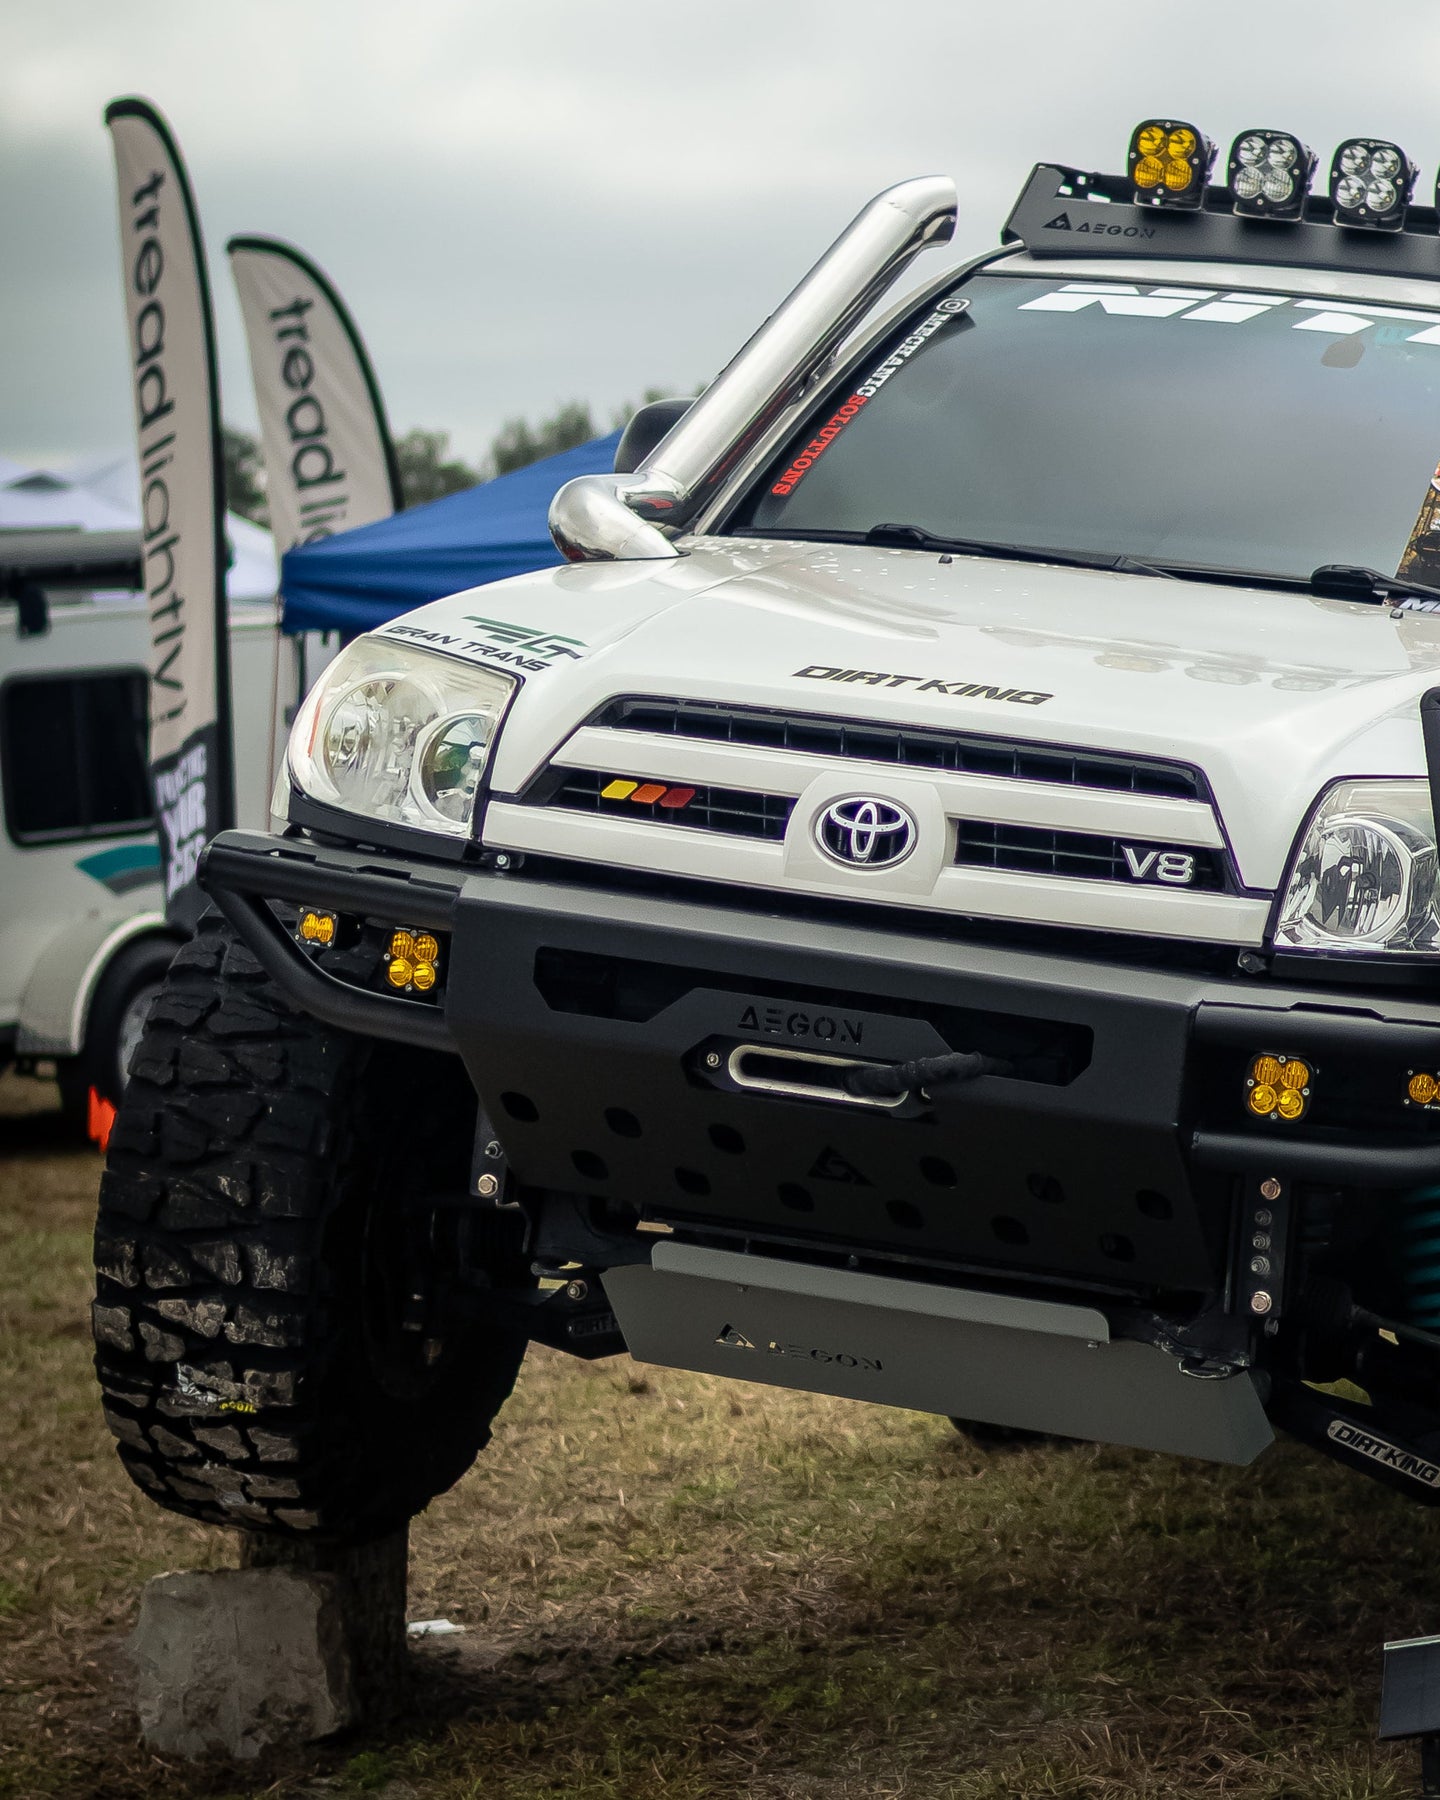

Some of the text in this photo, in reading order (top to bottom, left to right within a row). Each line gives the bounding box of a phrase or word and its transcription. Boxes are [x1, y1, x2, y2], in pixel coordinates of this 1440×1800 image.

[1075, 222, 1156, 239] AEGON
[385, 625, 553, 672] GRAN TRANS
[792, 665, 1055, 705] DIRT KING
[1121, 845, 1194, 883] V8
[738, 1006, 864, 1046] AEGON
